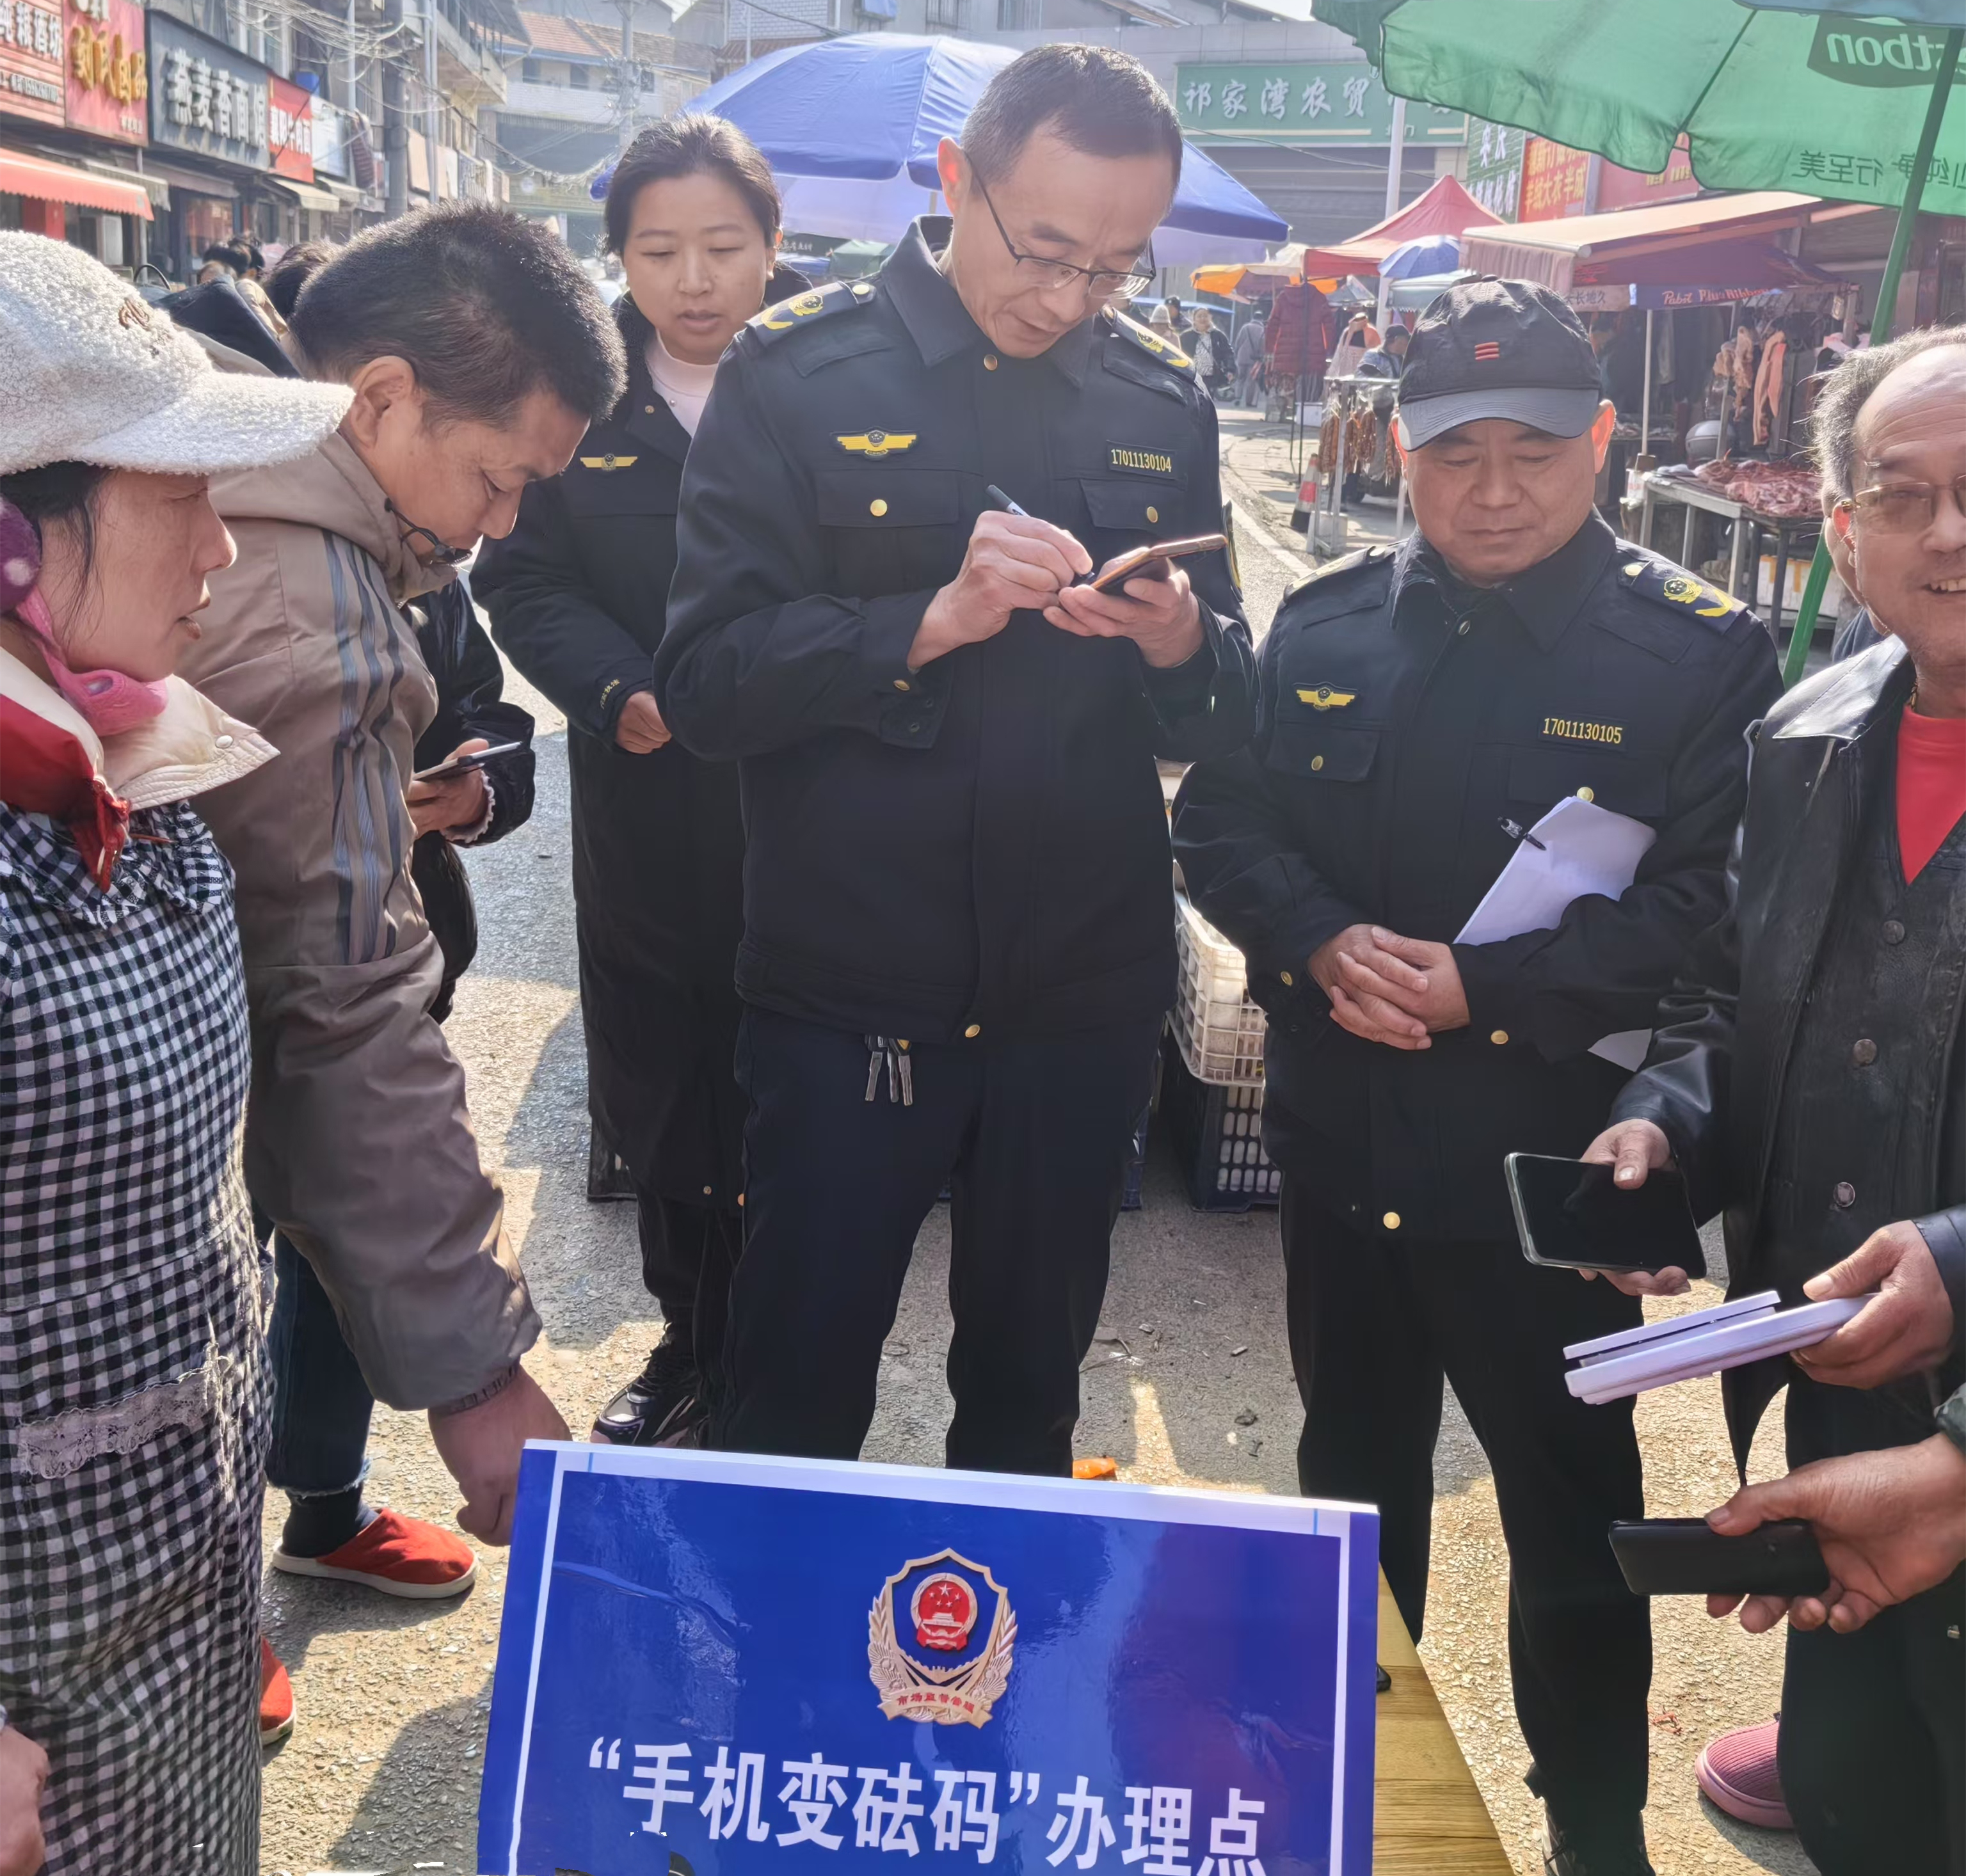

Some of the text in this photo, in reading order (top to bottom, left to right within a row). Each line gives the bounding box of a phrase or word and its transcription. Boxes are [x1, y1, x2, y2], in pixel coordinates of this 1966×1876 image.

[1183, 76, 1451, 122] 祁家湾农贸
[1662, 290, 1693, 305] Pabst
[1111, 449, 1172, 473] 17011130104
[1543, 717, 1623, 744] 17011130105
